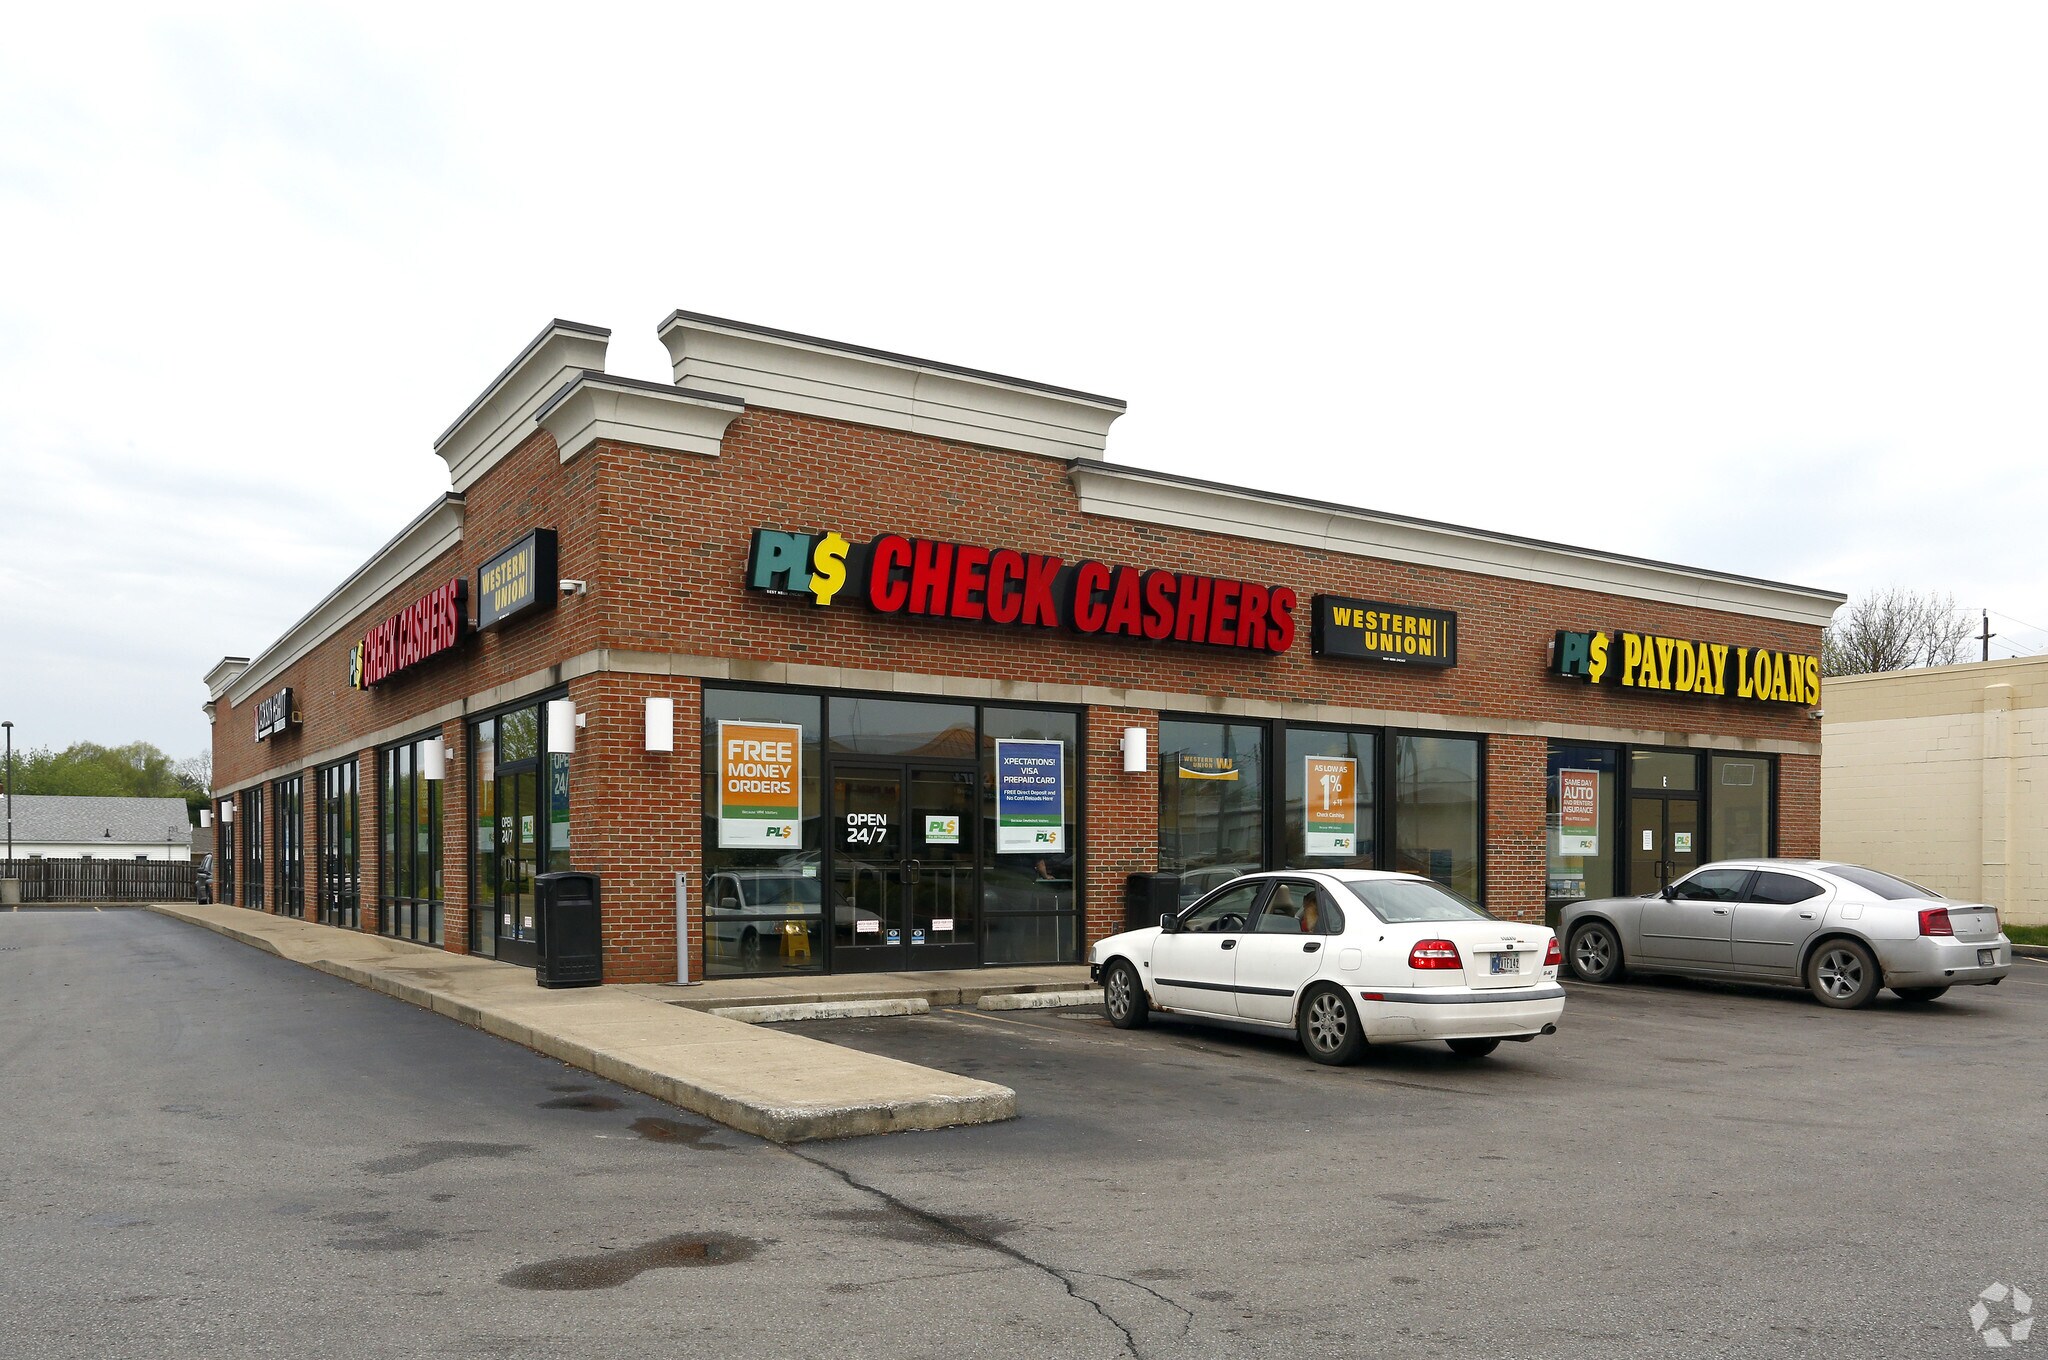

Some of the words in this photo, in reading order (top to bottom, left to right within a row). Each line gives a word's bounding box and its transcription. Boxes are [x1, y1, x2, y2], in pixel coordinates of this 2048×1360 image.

[482, 550, 525, 595] WESTERN
[495, 575, 525, 612] UNION
[868, 535, 1064, 627] CHECK
[1073, 559, 1297, 653] CASHERS
[364, 615, 397, 687] CHECK
[399, 577, 457, 670] CASHERS
[1332, 606, 1432, 636] WESTERN
[1365, 631, 1432, 656] UNION
[1621, 632, 1729, 695] PAYDAY
[1737, 648, 1819, 706] LOANS
[554, 753, 569, 769] OPE
[728, 740, 792, 762] FREE
[1003, 758, 1056, 766] XPECTATIONS!
[728, 763, 791, 778] MONEY
[554, 769, 569, 797] 24/
[728, 780, 791, 793] ORDERS
[1320, 774, 1342, 810] 1%
[1563, 786, 1594, 800] AUTO
[502, 816, 513, 828] OPEN
[846, 813, 887, 825] OPEN
[502, 828, 513, 845] 24/7
[846, 827, 887, 845] 24/7
